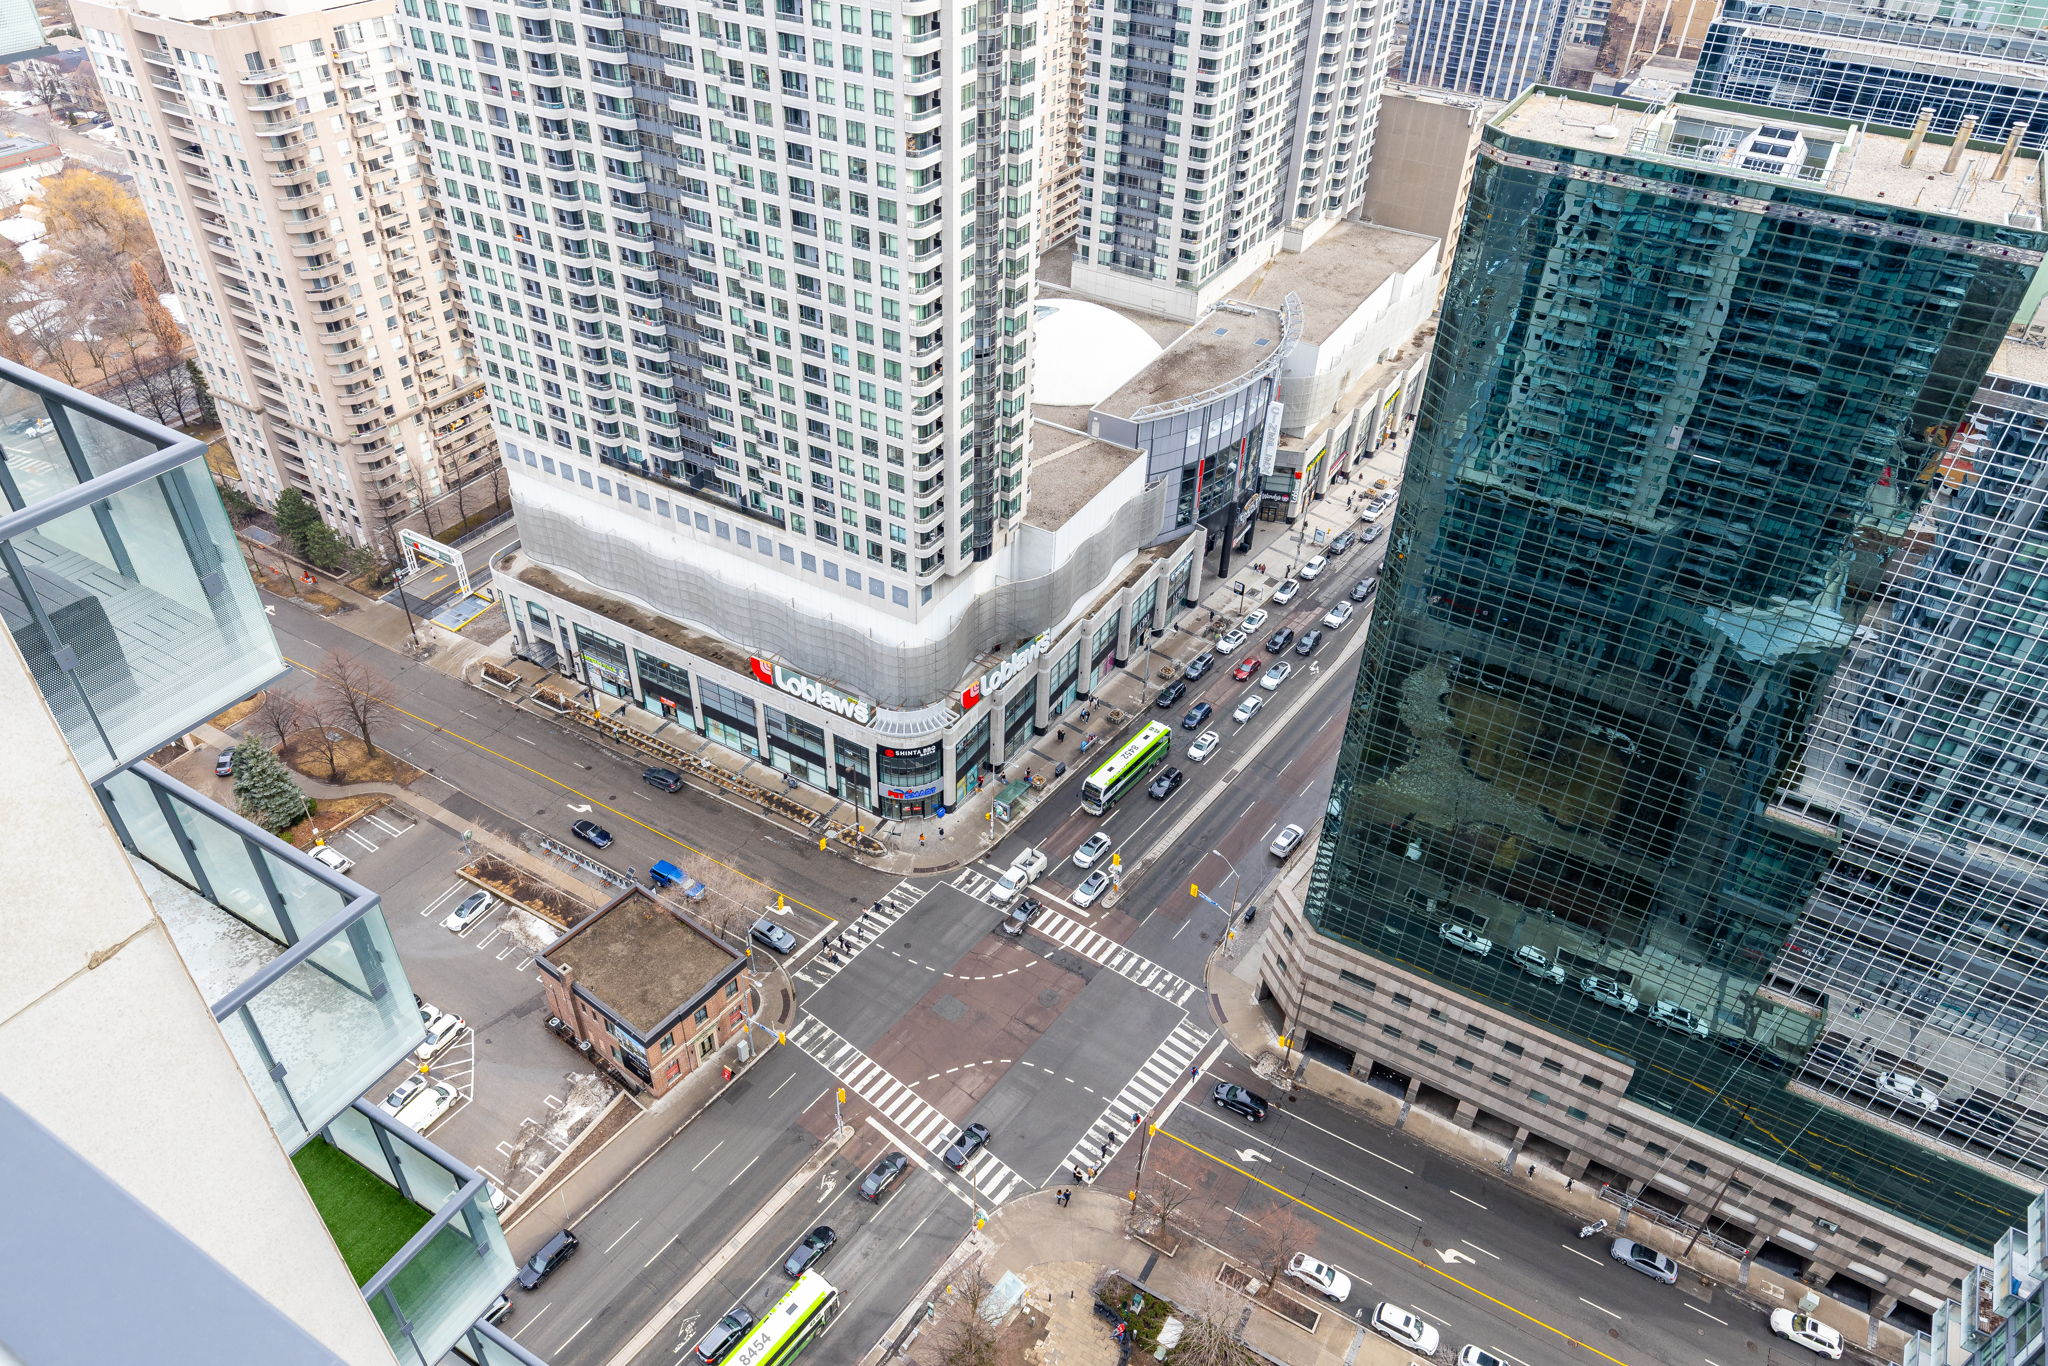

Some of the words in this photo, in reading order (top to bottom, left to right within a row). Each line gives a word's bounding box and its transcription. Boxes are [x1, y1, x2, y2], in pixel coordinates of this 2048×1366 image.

[980, 629, 1050, 697] Loblaws
[774, 664, 869, 724] Loblaws
[895, 749, 921, 757] SHINTA
[1120, 744, 1140, 760] 8452
[739, 1333, 771, 1366] 8454
